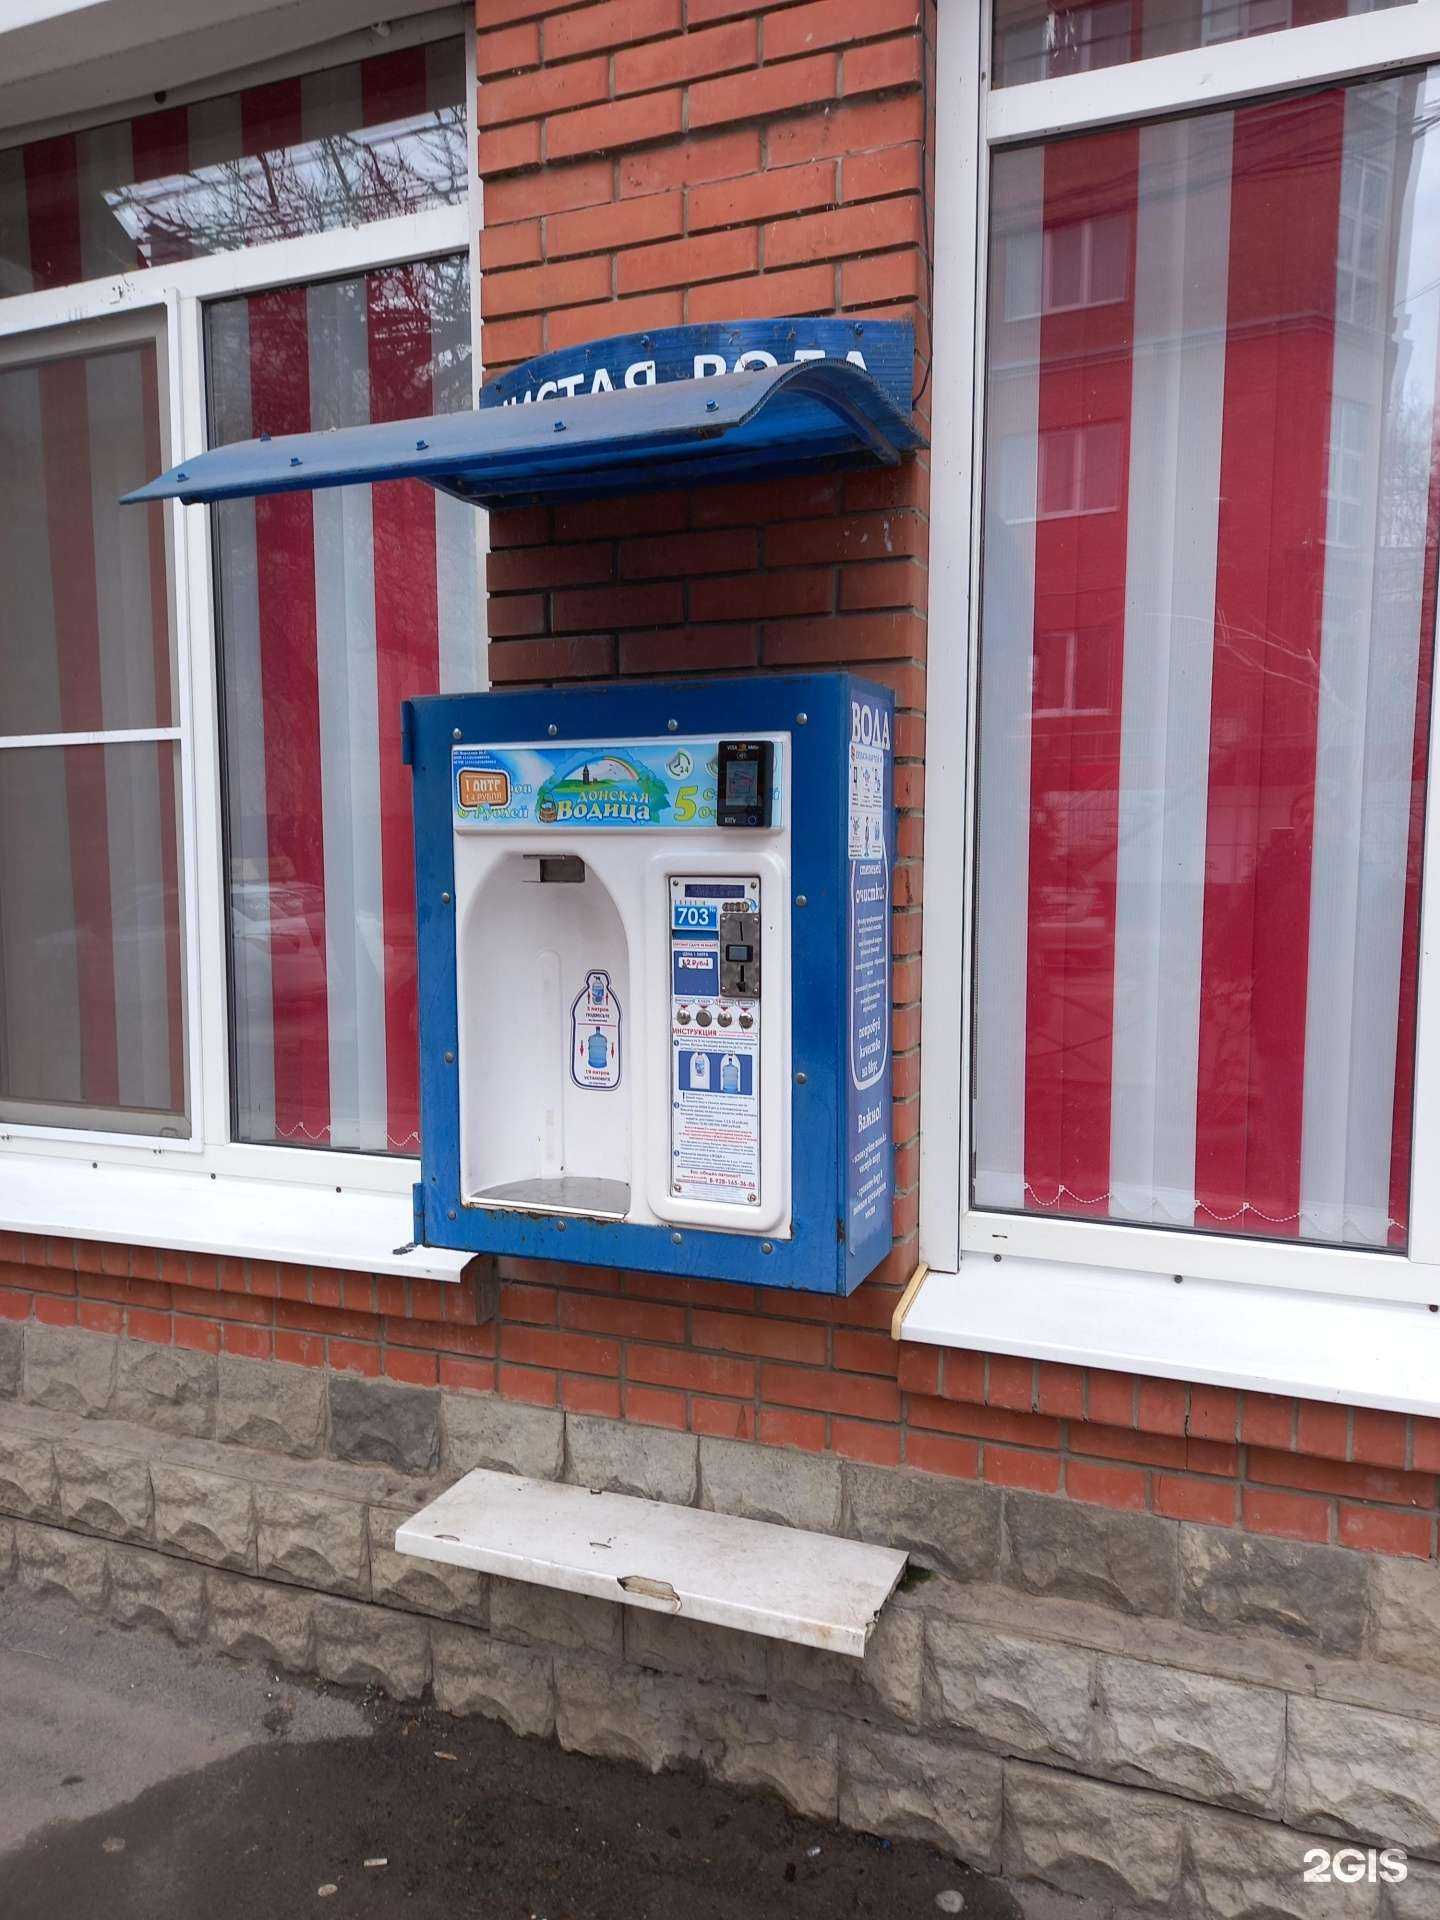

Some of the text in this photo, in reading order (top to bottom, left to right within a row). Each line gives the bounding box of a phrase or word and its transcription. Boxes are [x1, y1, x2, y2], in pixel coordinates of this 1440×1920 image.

[503, 360, 656, 407] СТАЯ
[851, 702, 890, 750] ВОДА
[556, 799, 650, 822] Водица
[579, 790, 649, 803] ДОНСКАЯ
[674, 785, 698, 821] 5
[677, 907, 709, 925] 703
[672, 1027, 717, 1037] ИНСТРУКЦИЯ
[857, 1101, 882, 1134] Важно!
